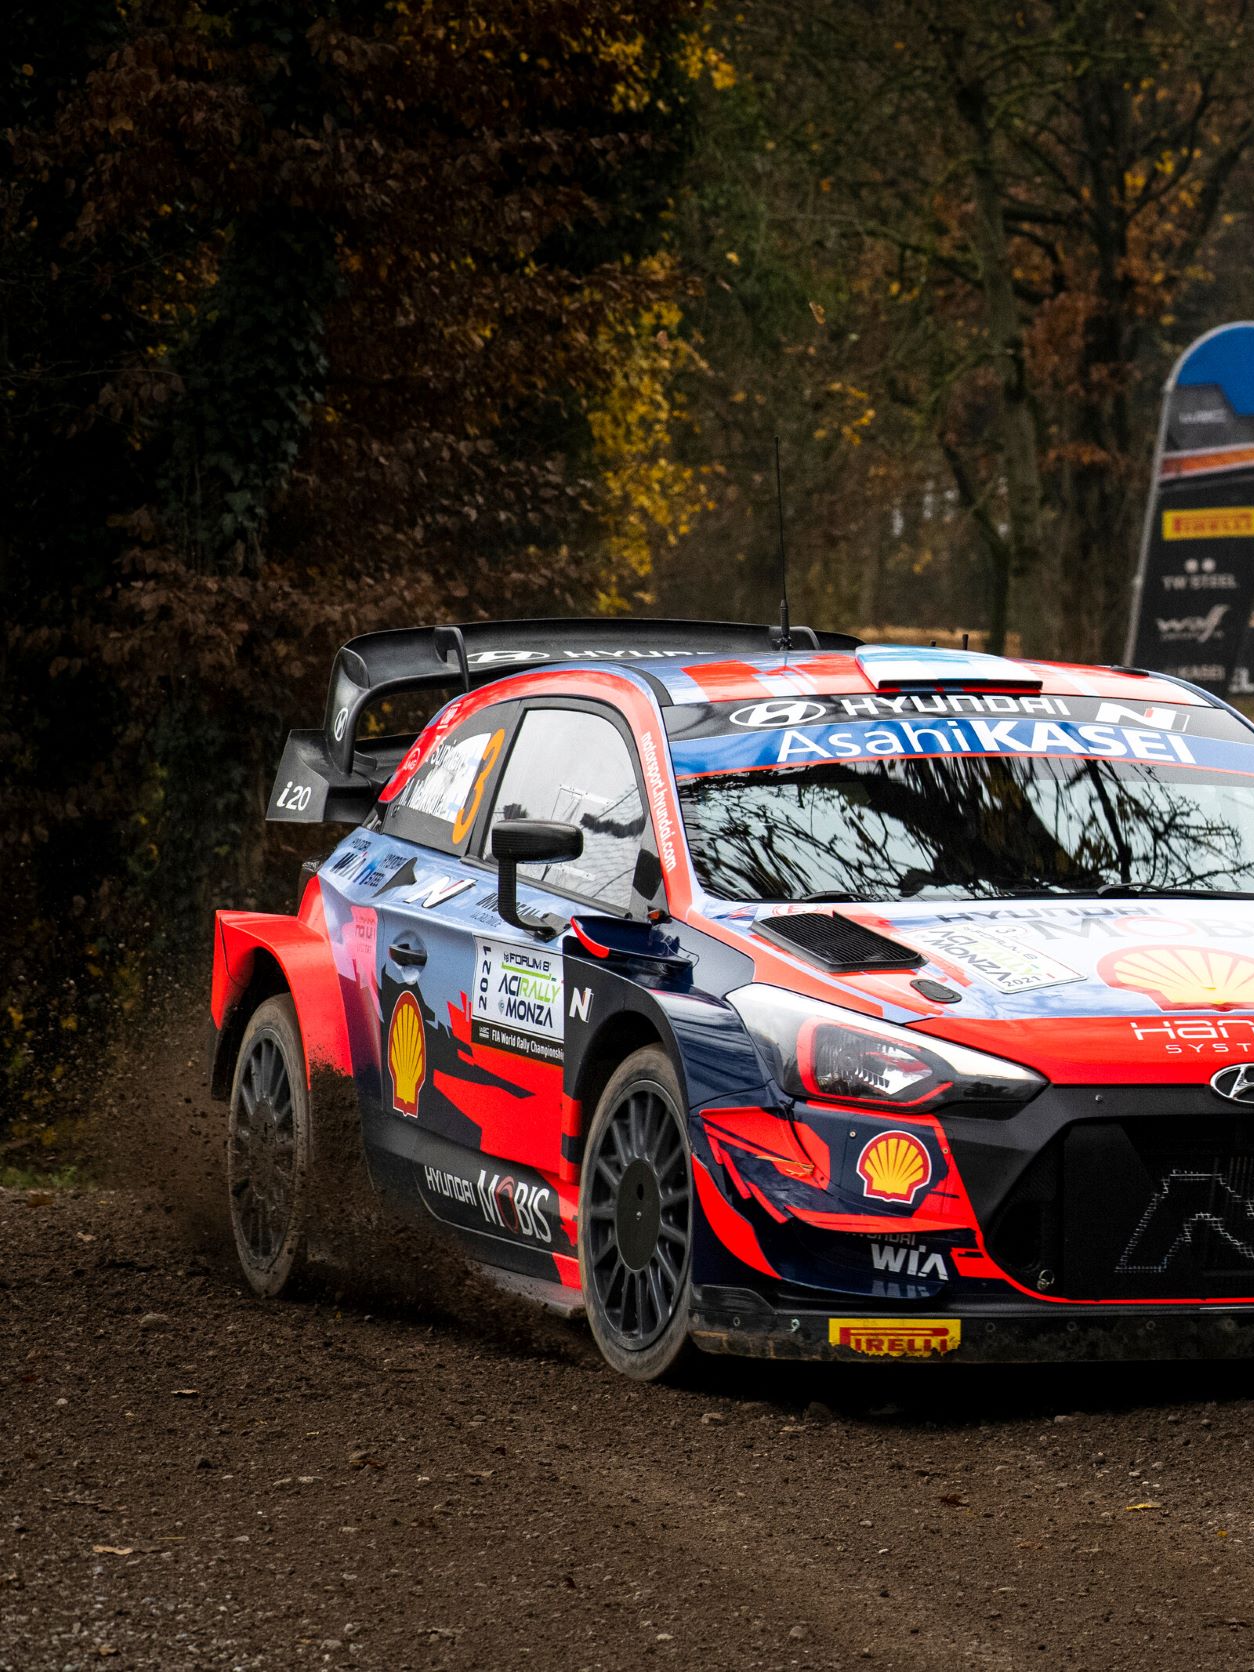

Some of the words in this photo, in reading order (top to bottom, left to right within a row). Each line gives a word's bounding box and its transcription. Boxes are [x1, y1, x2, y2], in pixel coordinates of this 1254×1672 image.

[841, 693, 1070, 716] HYUNDAI
[776, 718, 1198, 765] AsahiKASEI
[276, 780, 312, 812] i20
[452, 728, 506, 845] 3
[640, 730, 679, 873] motorsport.hyundai.com
[936, 905, 1165, 923] HYUNDAI
[509, 952, 542, 972] FORUM
[924, 939, 1013, 982] MONZA
[478, 945, 492, 1012] 2021
[1005, 975, 1041, 988] 2021
[505, 997, 553, 1029] MONZA
[491, 1029, 501, 1043] FIA
[501, 1032, 516, 1047] World
[516, 1035, 530, 1053] Rally
[424, 1165, 478, 1207] HYUNDAI
[477, 1169, 552, 1244] MOBIS
[870, 1243, 949, 1281] WIA
[839, 1326, 950, 1353] PIRELLI
